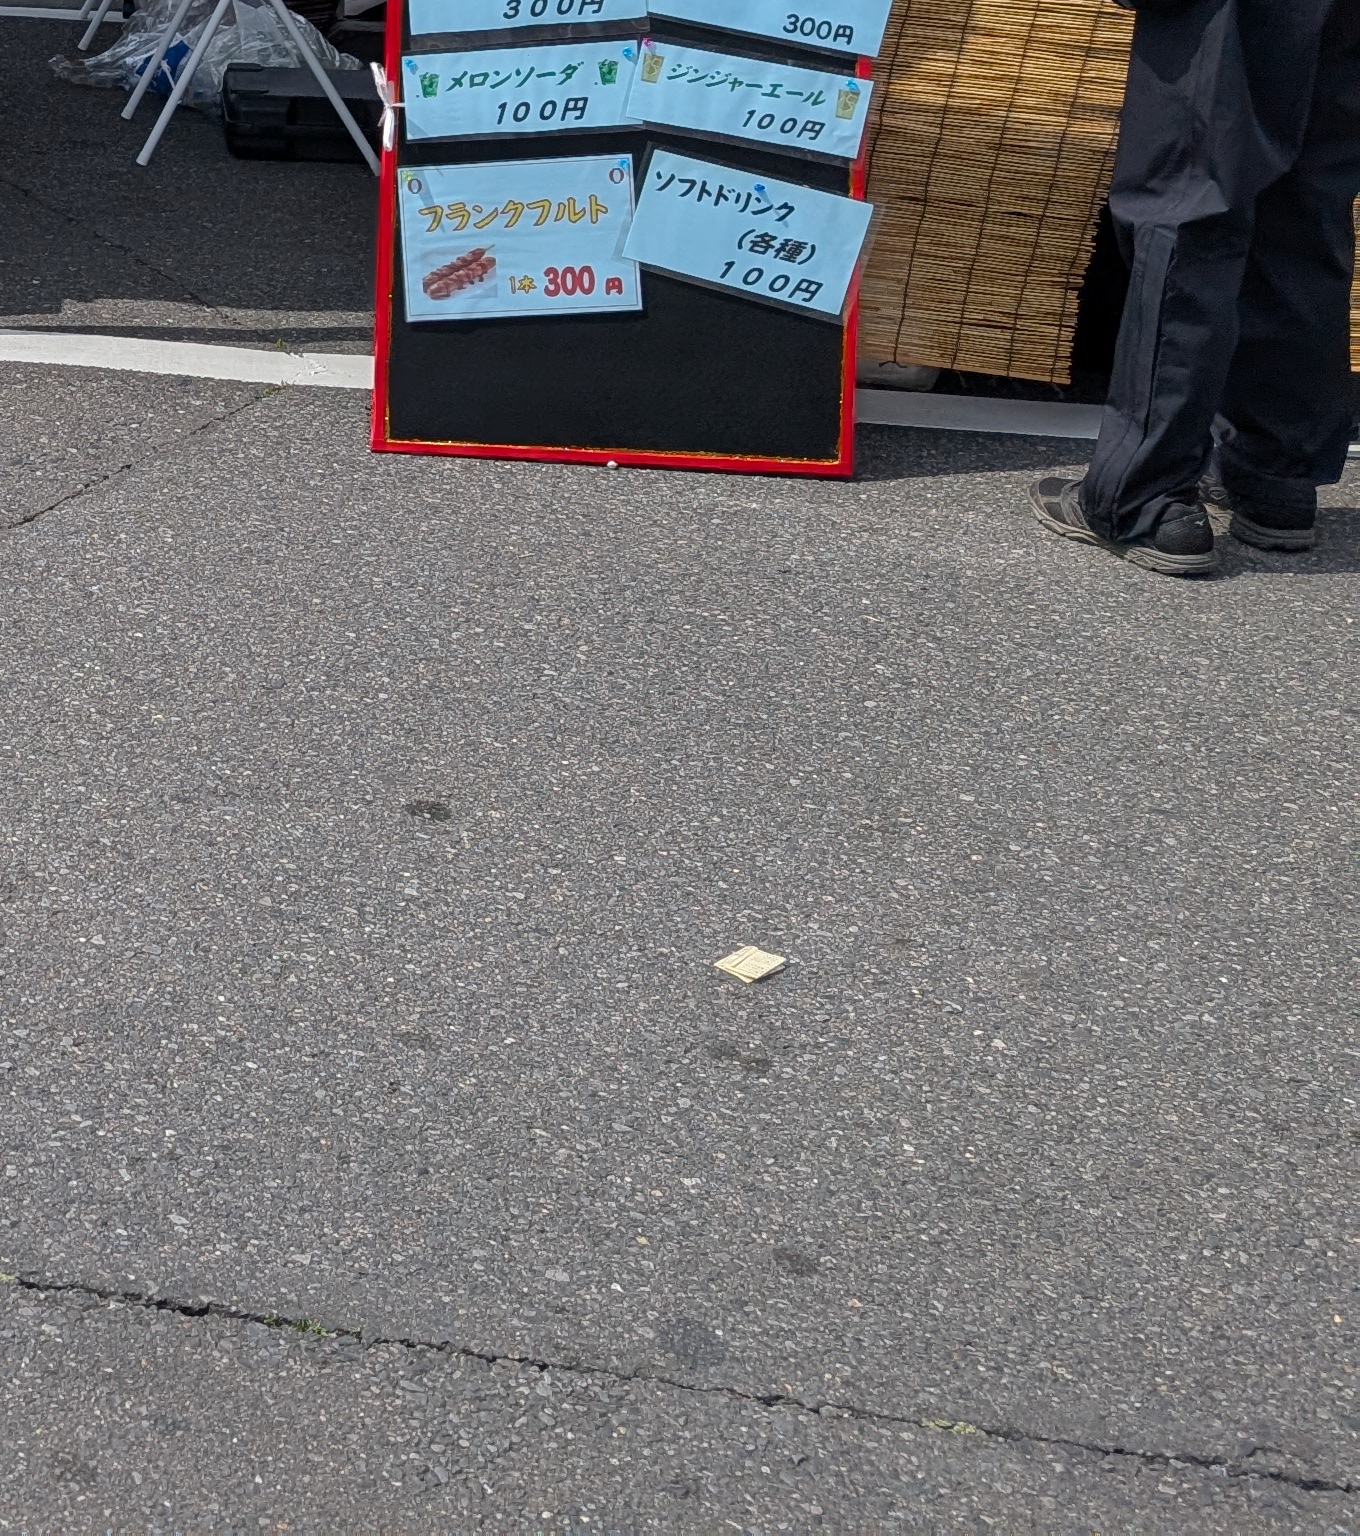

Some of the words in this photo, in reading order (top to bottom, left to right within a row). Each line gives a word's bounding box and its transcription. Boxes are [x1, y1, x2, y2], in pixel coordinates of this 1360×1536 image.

[782, 14, 855, 46] 300円
[444, 62, 584, 93] メロンソーダ
[665, 63, 827, 107] ジンジャーエール
[496, 96, 589, 126] 100円
[741, 109, 826, 142] 100円
[418, 193, 609, 233] フランクフルト
[655, 168, 797, 222] ソフトドリンク
[736, 227, 817, 266] (各種)
[509, 275, 537, 295] 1本
[718, 259, 825, 304] 100円
